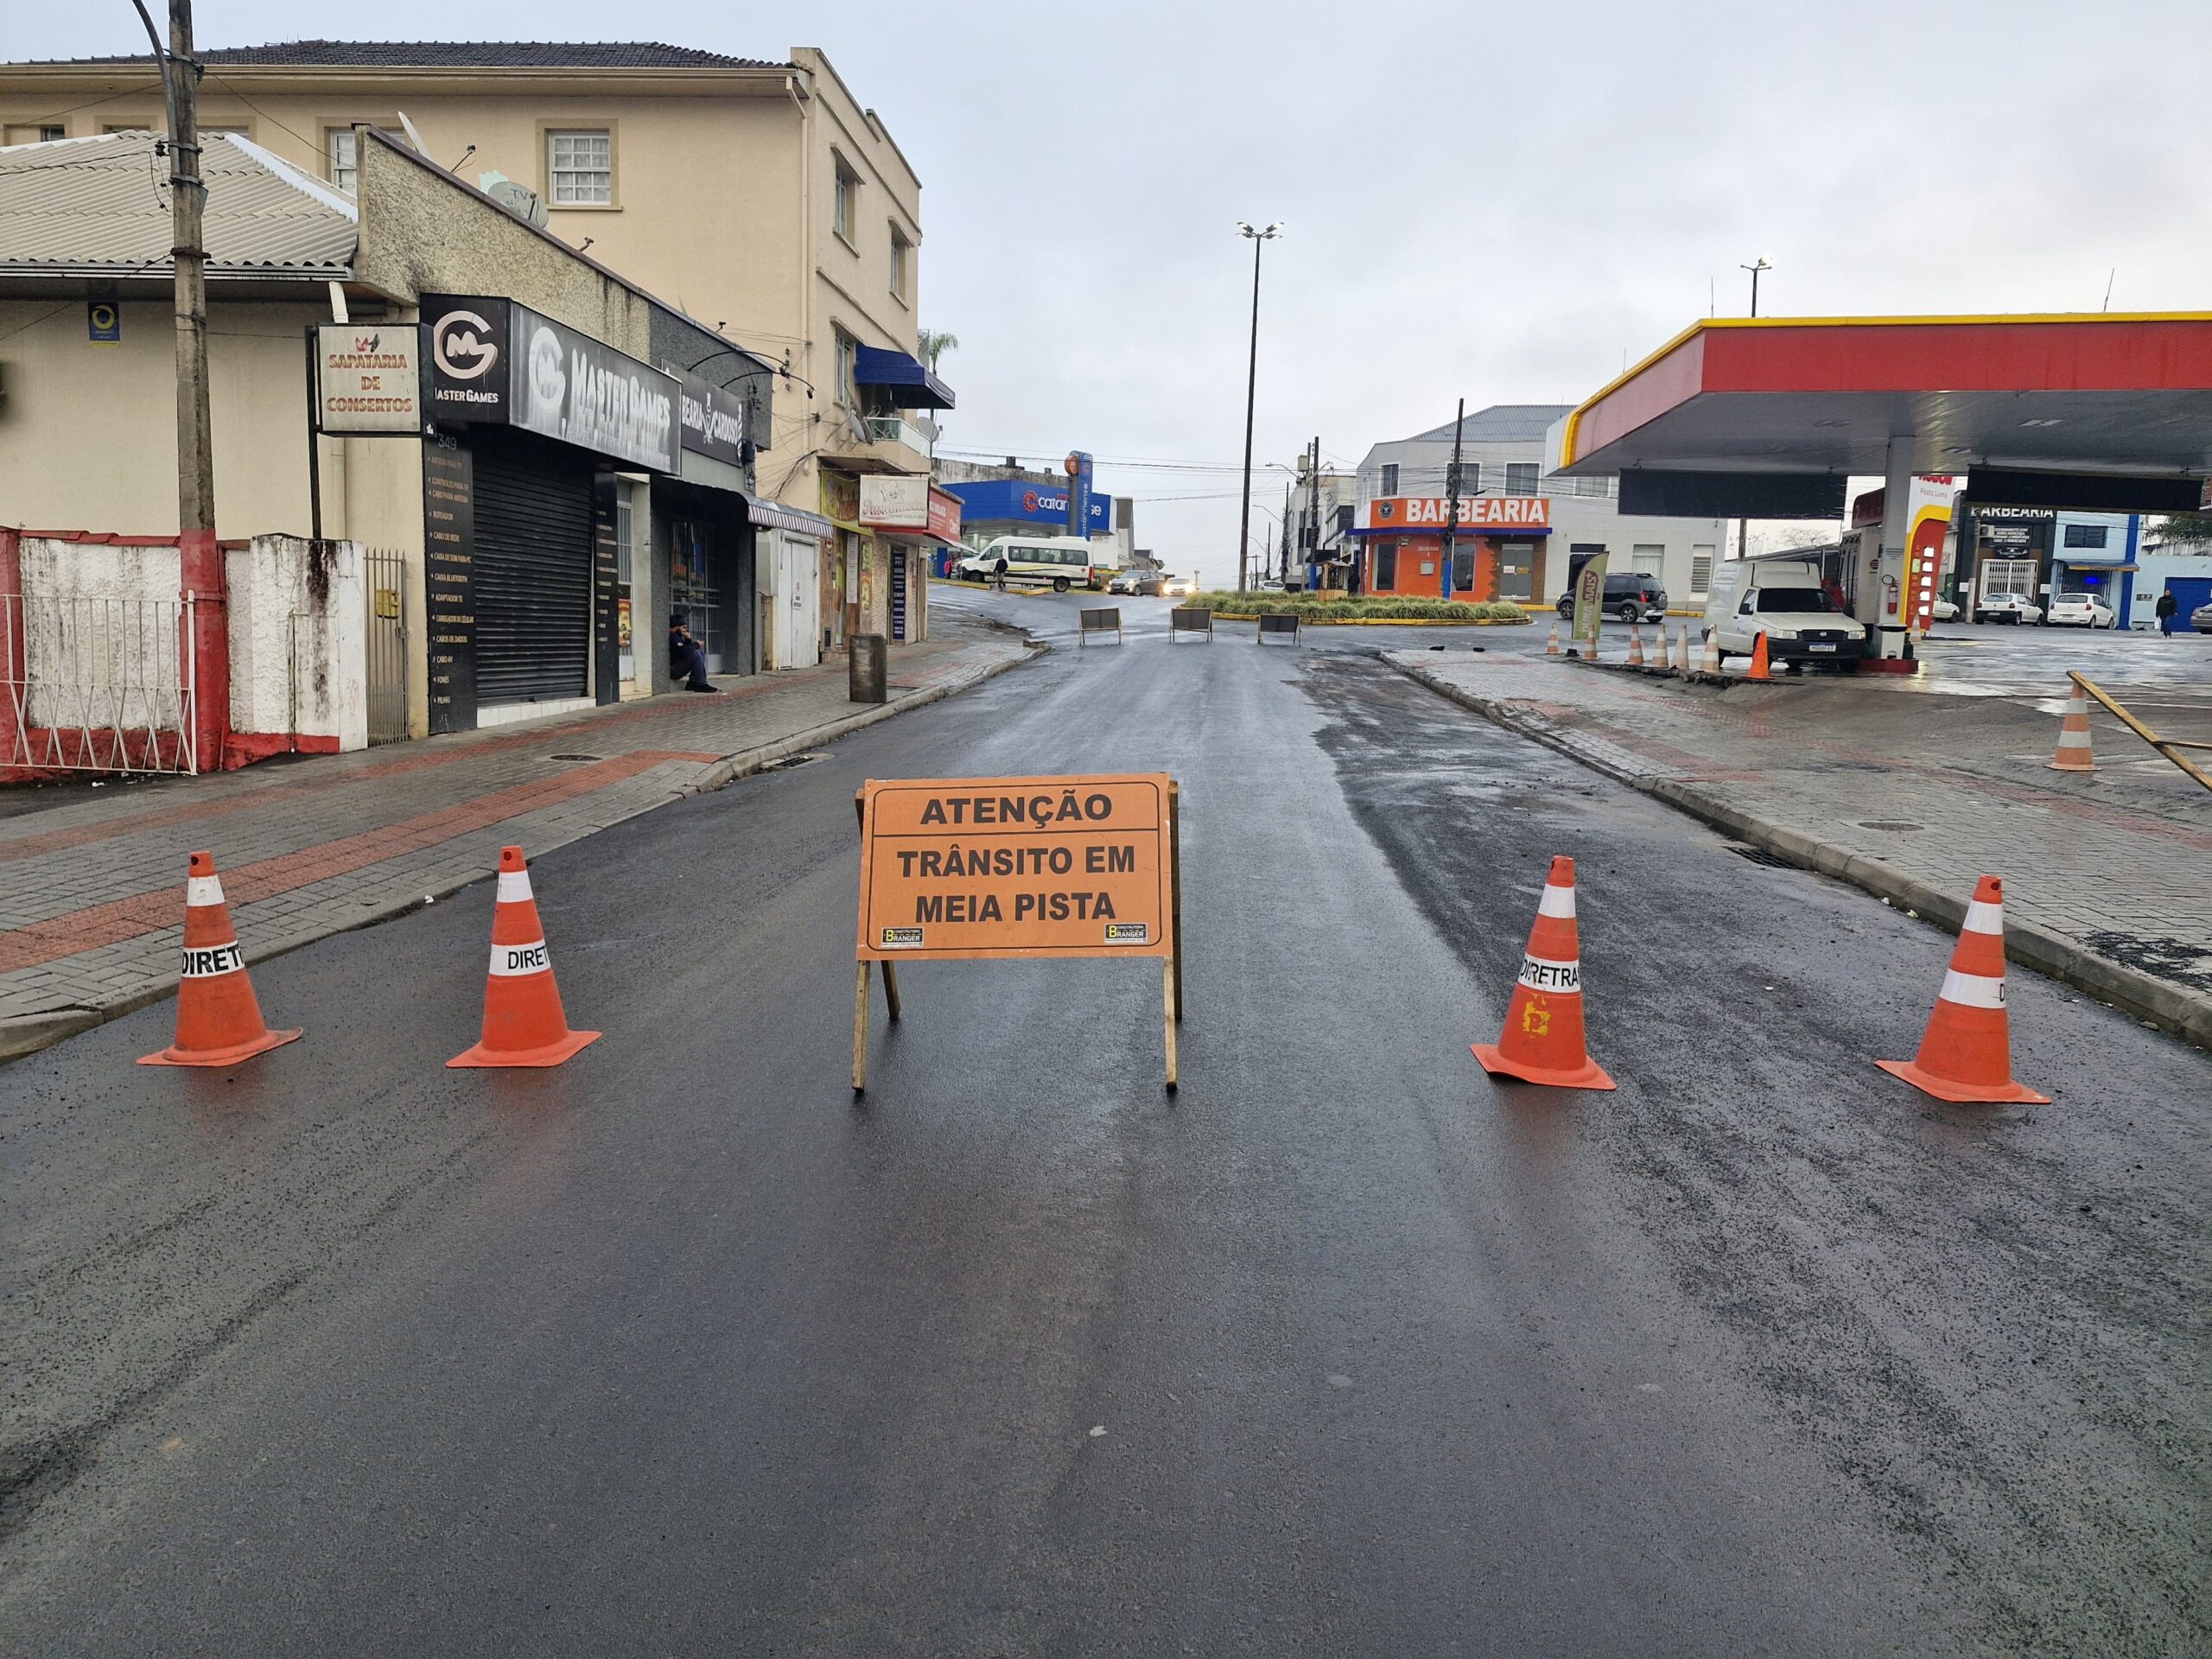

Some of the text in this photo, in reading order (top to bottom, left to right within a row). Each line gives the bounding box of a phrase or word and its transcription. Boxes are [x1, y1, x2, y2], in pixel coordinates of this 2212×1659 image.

[511, 188, 529, 201] TV
[328, 354, 408, 369] SAPATARIA
[360, 376, 380, 391] DE
[327, 397, 413, 413] CONSERTOS
[438, 434, 458, 451] 349
[1920, 487, 1934, 497] Posto
[1406, 499, 1546, 523] BARBEARIA
[920, 788, 1112, 829] ATENÇÃO
[897, 843, 1135, 878] TRÂNSITO EM
[915, 892, 1116, 923] MEIA PISTA
[886, 929, 920, 942] BRANGER
[1109, 925, 1144, 938] BRANGER
[1520, 958, 1580, 987] DIRETRA
